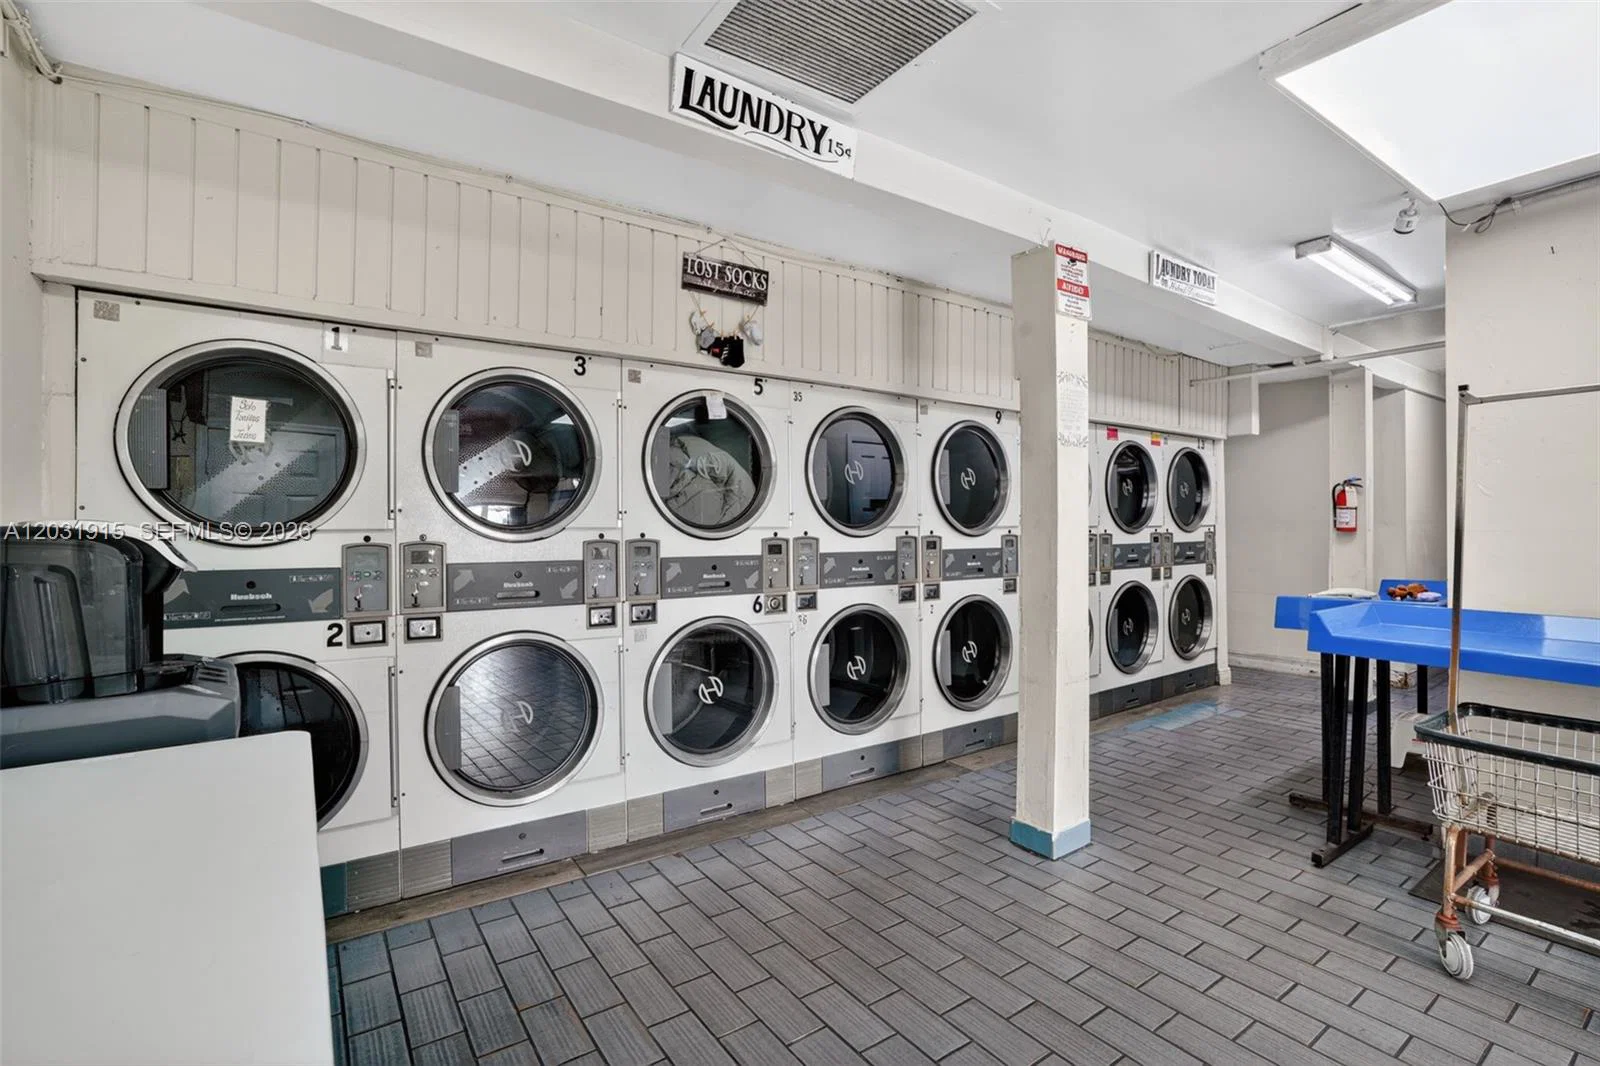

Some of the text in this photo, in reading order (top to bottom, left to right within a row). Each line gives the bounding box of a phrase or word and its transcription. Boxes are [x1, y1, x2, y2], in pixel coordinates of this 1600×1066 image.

[679, 66, 829, 156] LAUNDRY
[687, 256, 722, 280] LOST
[725, 265, 767, 291] SOCKS
[1155, 253, 1217, 290] LAUNDRY TODAY
[330, 326, 343, 351] 1
[573, 355, 587, 376] 3
[753, 377, 764, 396] 5
[995, 410, 1002, 425] 9
[752, 595, 763, 614] 6
[326, 622, 344, 648] 2
